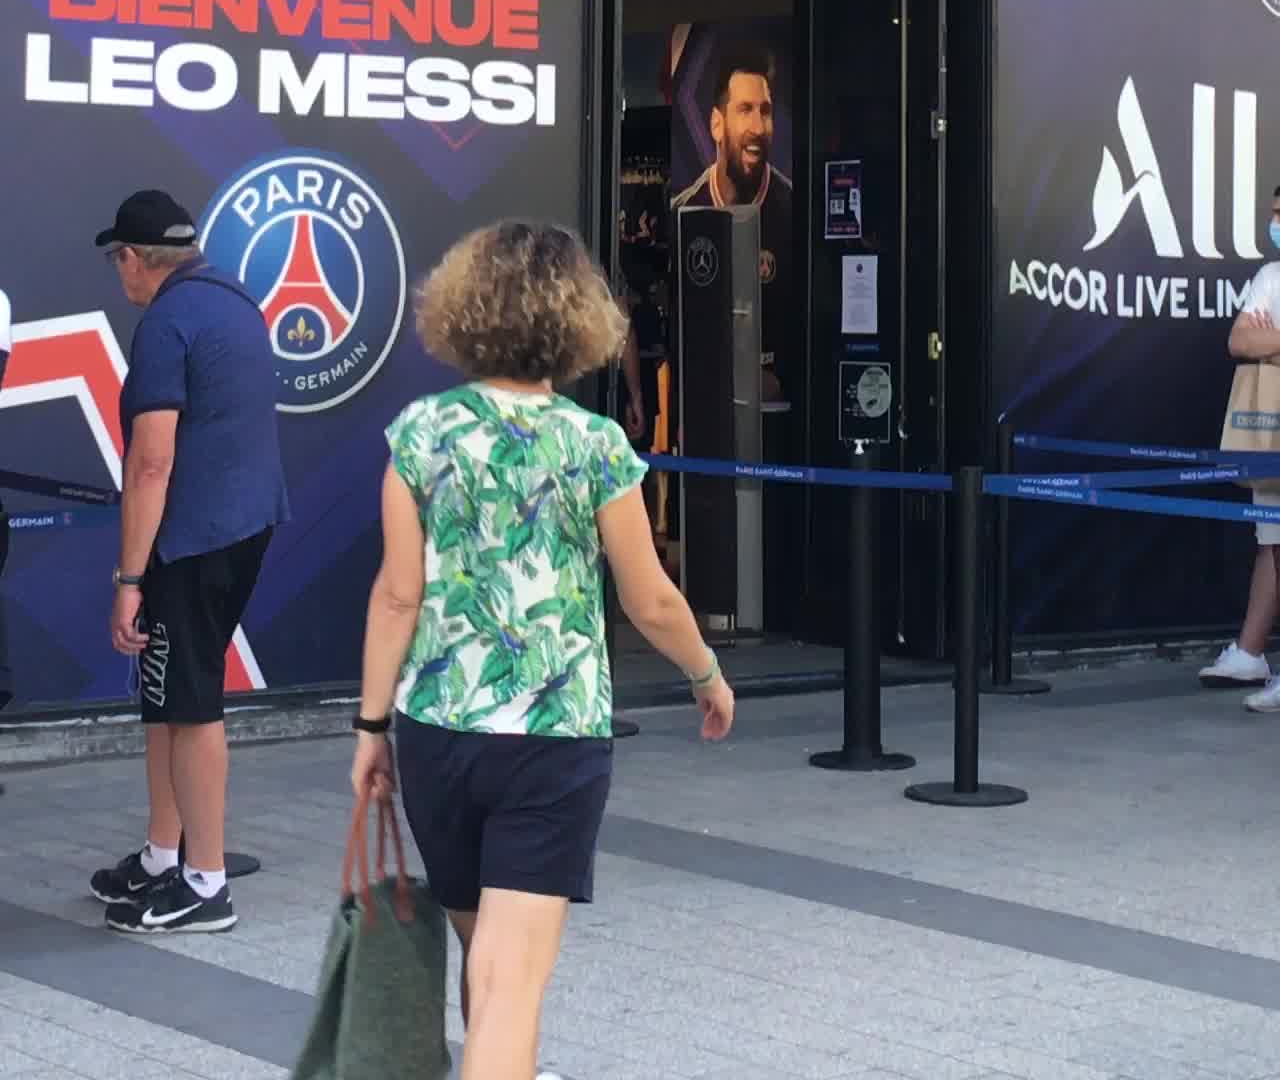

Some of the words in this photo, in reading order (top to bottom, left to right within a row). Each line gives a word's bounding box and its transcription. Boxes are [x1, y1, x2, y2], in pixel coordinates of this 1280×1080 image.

[25, 32, 238, 111] LEO
[258, 48, 556, 126] MESSI
[232, 169, 371, 231] PARIS
[1009, 258, 1109, 316] ACCOR
[1116, 272, 1190, 319] LIVE
[1197, 277, 1254, 319] LIM
[294, 340, 369, 391] GERMAIN
